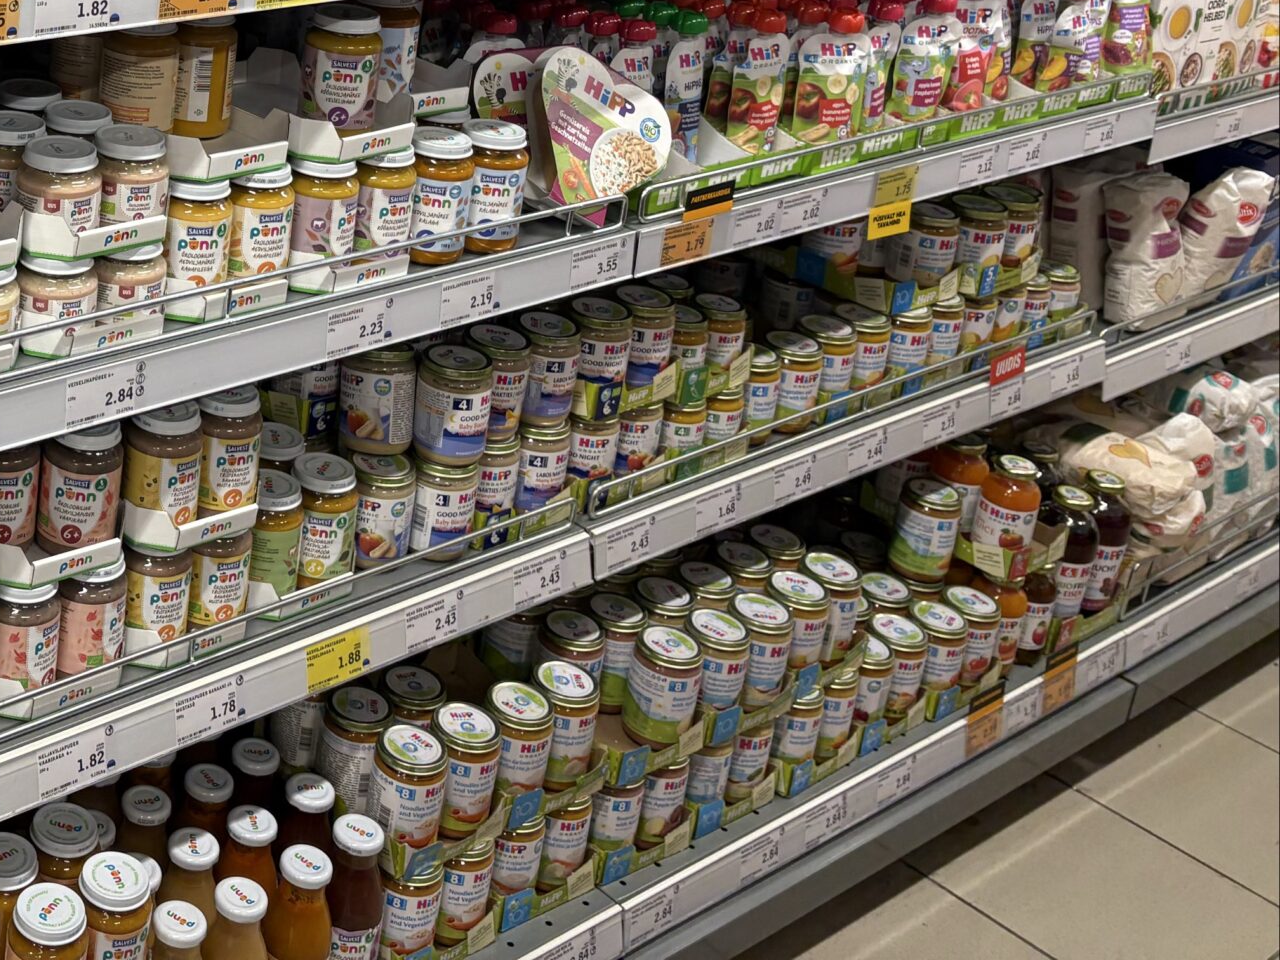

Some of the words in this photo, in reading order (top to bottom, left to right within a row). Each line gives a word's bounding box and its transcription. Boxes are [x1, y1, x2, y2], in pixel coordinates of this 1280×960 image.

[597, 260, 618, 275] 3.55
[359, 321, 383, 338] 2.23
[995, 352, 1022, 377] UUDIS
[540, 571, 562, 588] 2.43
[338, 650, 361, 669] 1.88
[210, 699, 236, 720] 1.78
[77, 751, 105, 771] 1.82
